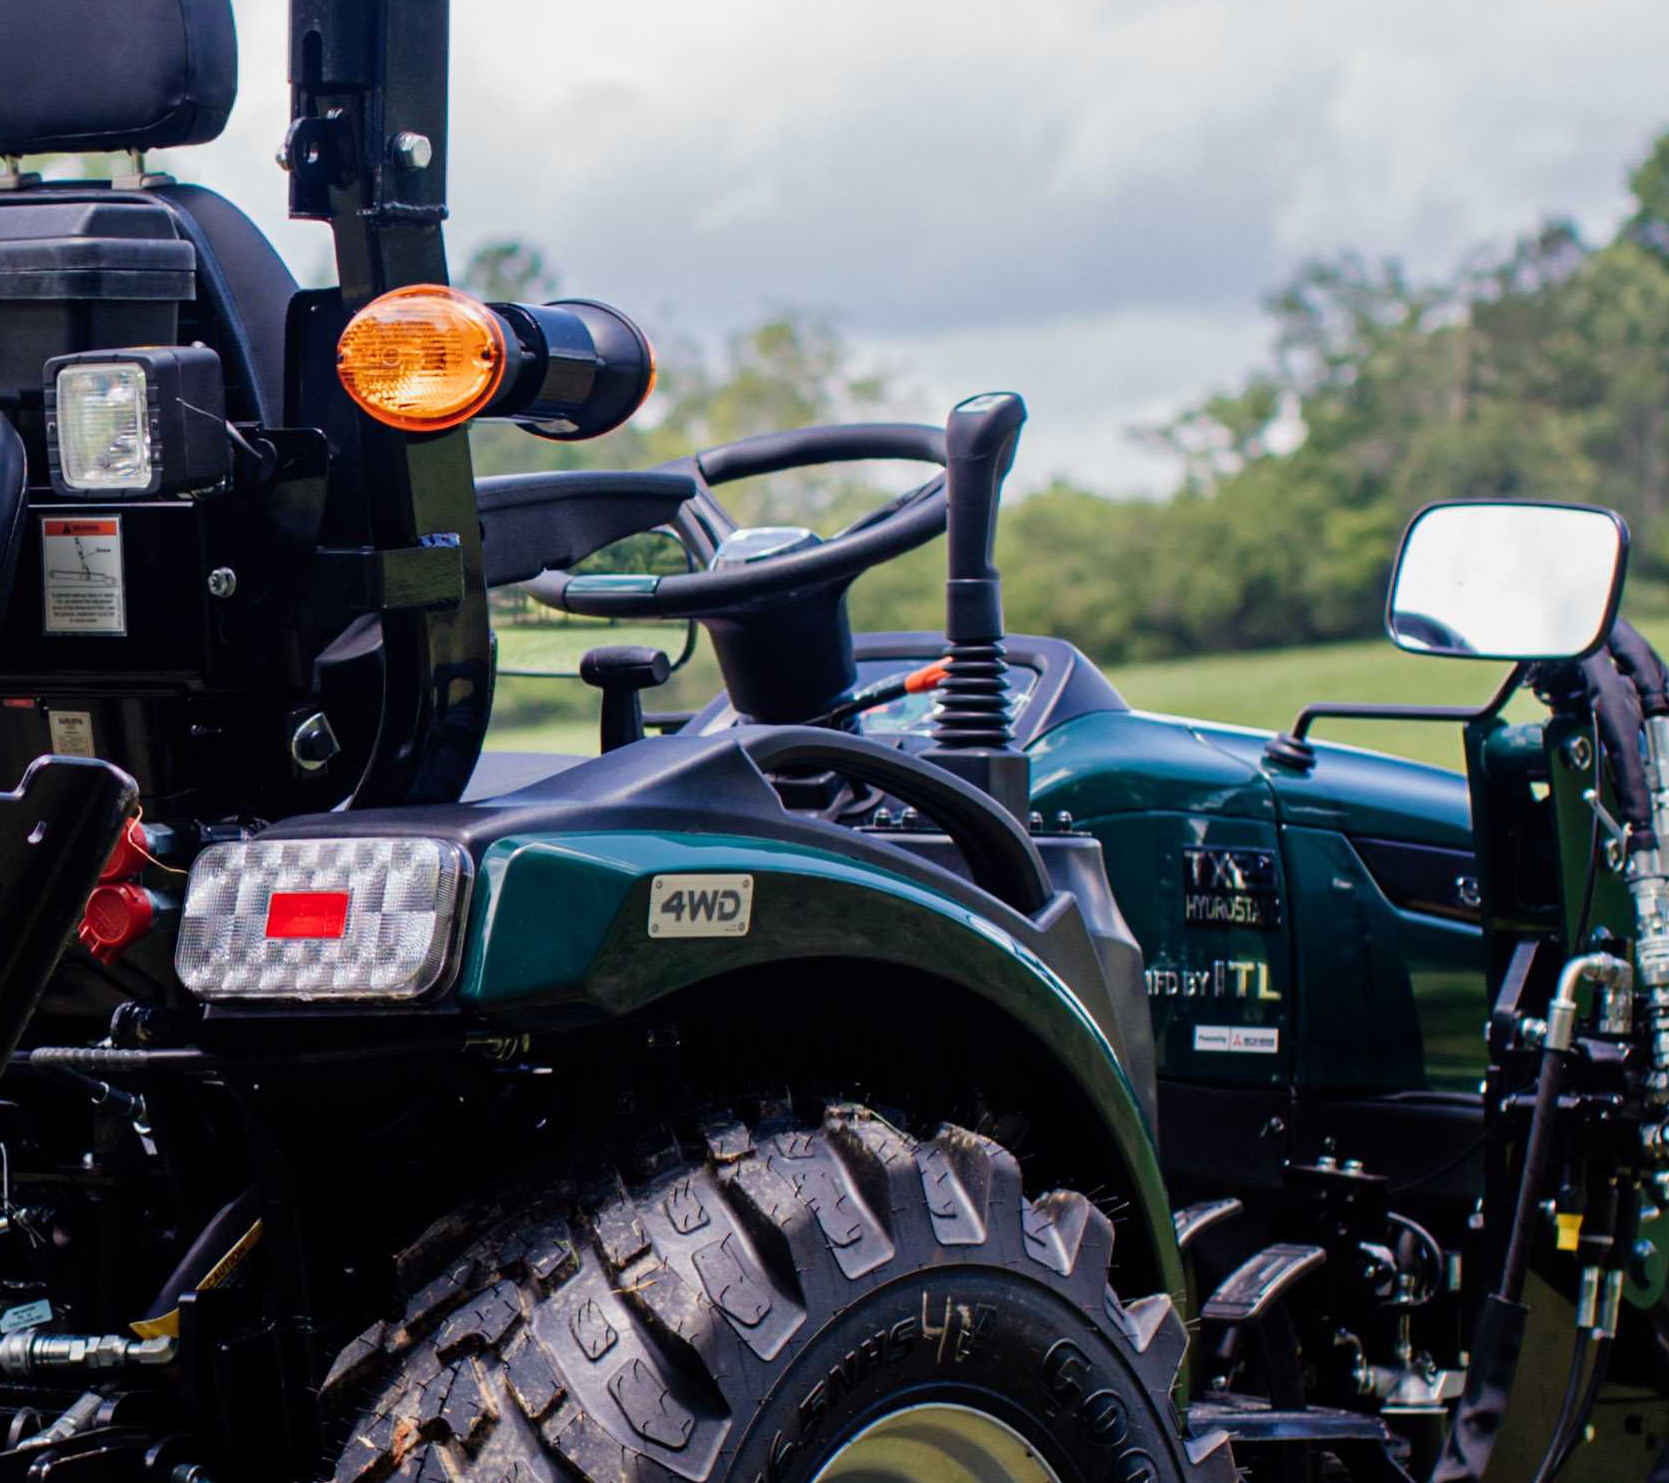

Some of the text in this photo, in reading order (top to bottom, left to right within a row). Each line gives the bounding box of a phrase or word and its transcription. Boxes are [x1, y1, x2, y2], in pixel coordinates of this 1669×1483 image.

[661, 890, 741, 922] 4WD
[1182, 970, 1211, 996] BY
[1214, 959, 1282, 1000] ITL
[206, 1244, 247, 1289] CAUTION
